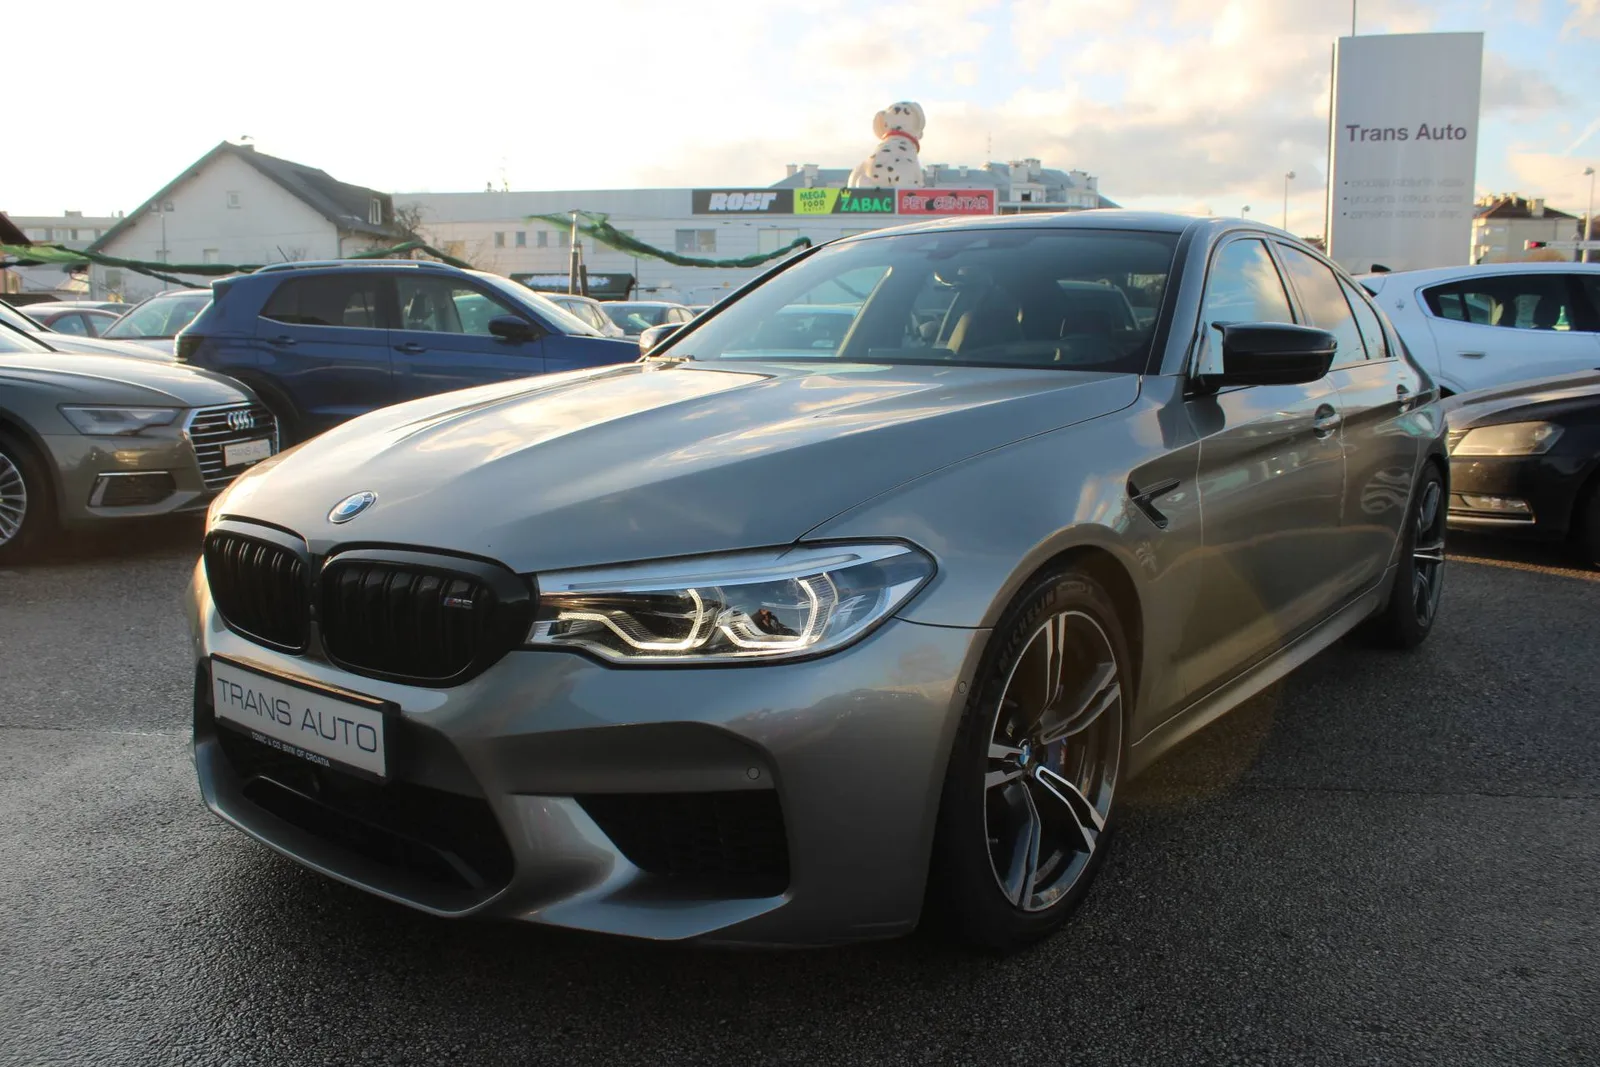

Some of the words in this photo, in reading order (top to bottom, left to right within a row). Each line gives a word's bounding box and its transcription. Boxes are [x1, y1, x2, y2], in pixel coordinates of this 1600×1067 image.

[1346, 124, 1409, 142] Trans
[1415, 123, 1467, 141] Auto
[708, 192, 778, 211] ROST
[800, 190, 827, 202] MEGA
[803, 199, 825, 208] FOOD
[902, 195, 926, 211] PET
[933, 195, 989, 211] CENTAR
[217, 677, 292, 726] TRANS
[301, 708, 377, 753] AUTO
[305, 752, 331, 768] CROATIA
